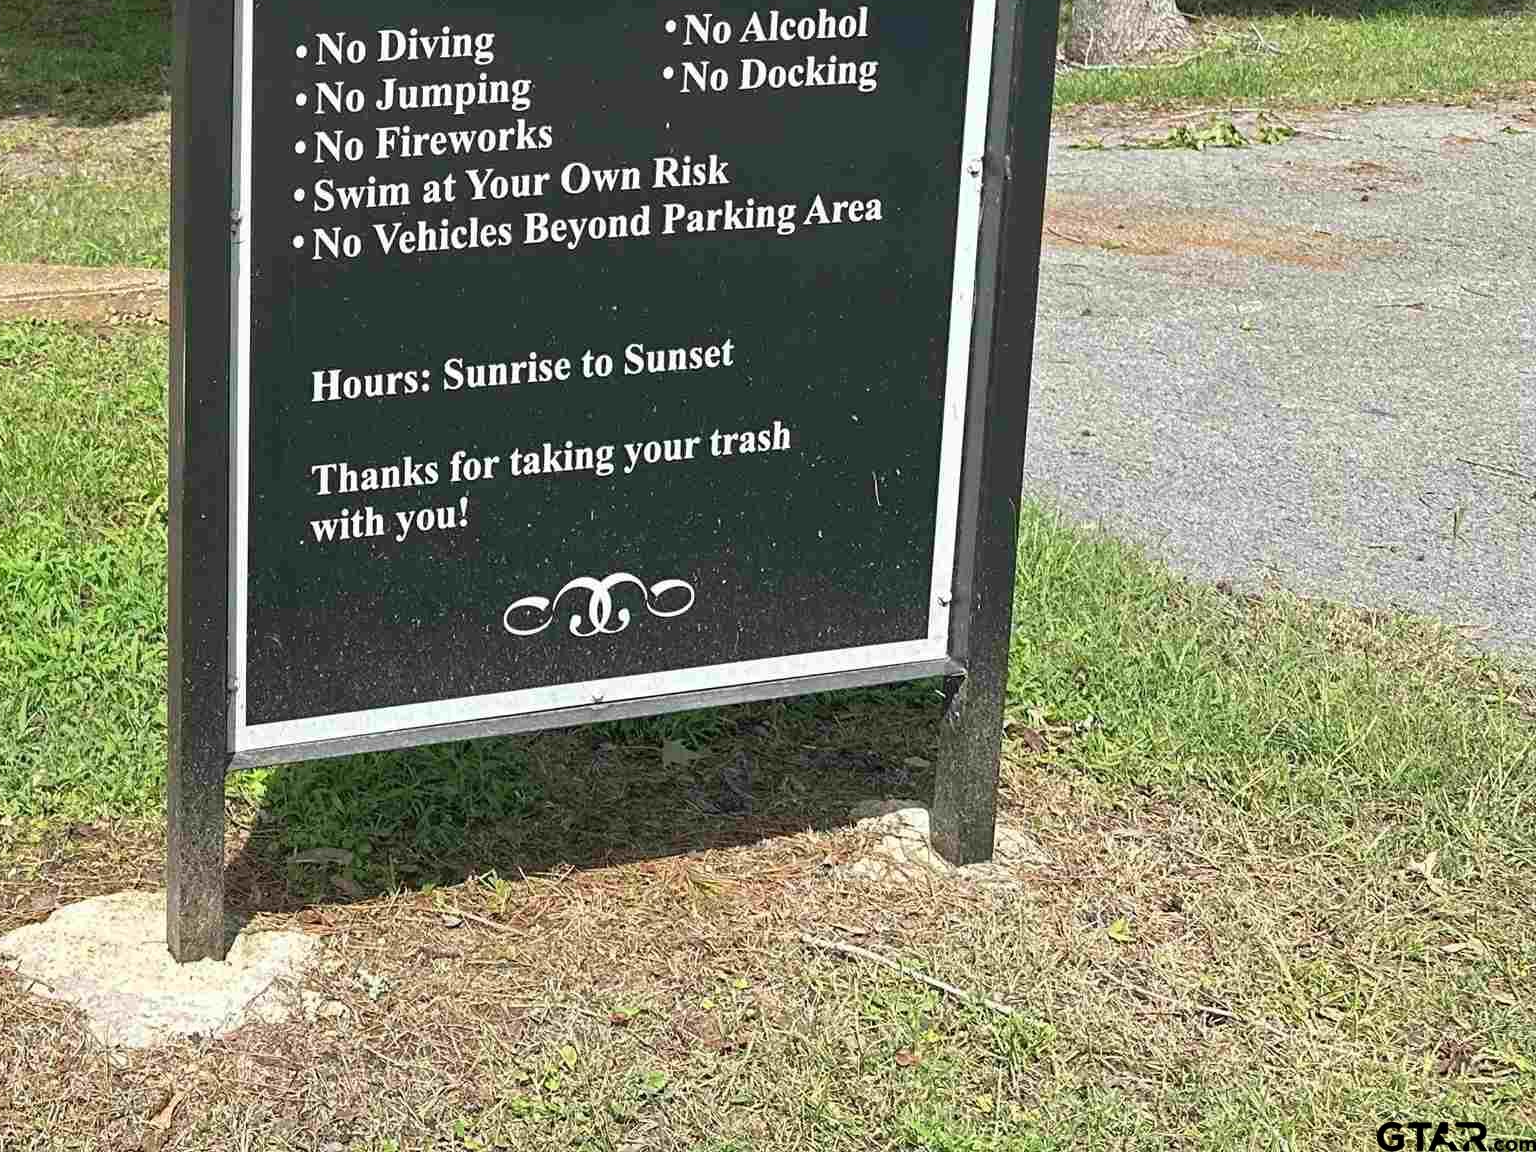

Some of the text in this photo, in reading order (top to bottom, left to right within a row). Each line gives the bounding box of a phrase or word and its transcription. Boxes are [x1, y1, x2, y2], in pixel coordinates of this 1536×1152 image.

[315, 25, 496, 66] No Diving
[682, 5, 868, 46] No Alcohol
[314, 72, 532, 116] No Jumping
[679, 55, 879, 93] No Docking
[313, 118, 553, 164] No Fireworks
[313, 154, 730, 212] Swim at Your Own Risk
[311, 193, 883, 260] No Vehicles Beyond Parking Area
[311, 338, 735, 402] Hours: Sunrise to Sunset
[311, 420, 791, 496] Thanks for taking your trash
[309, 496, 468, 543] with you!
